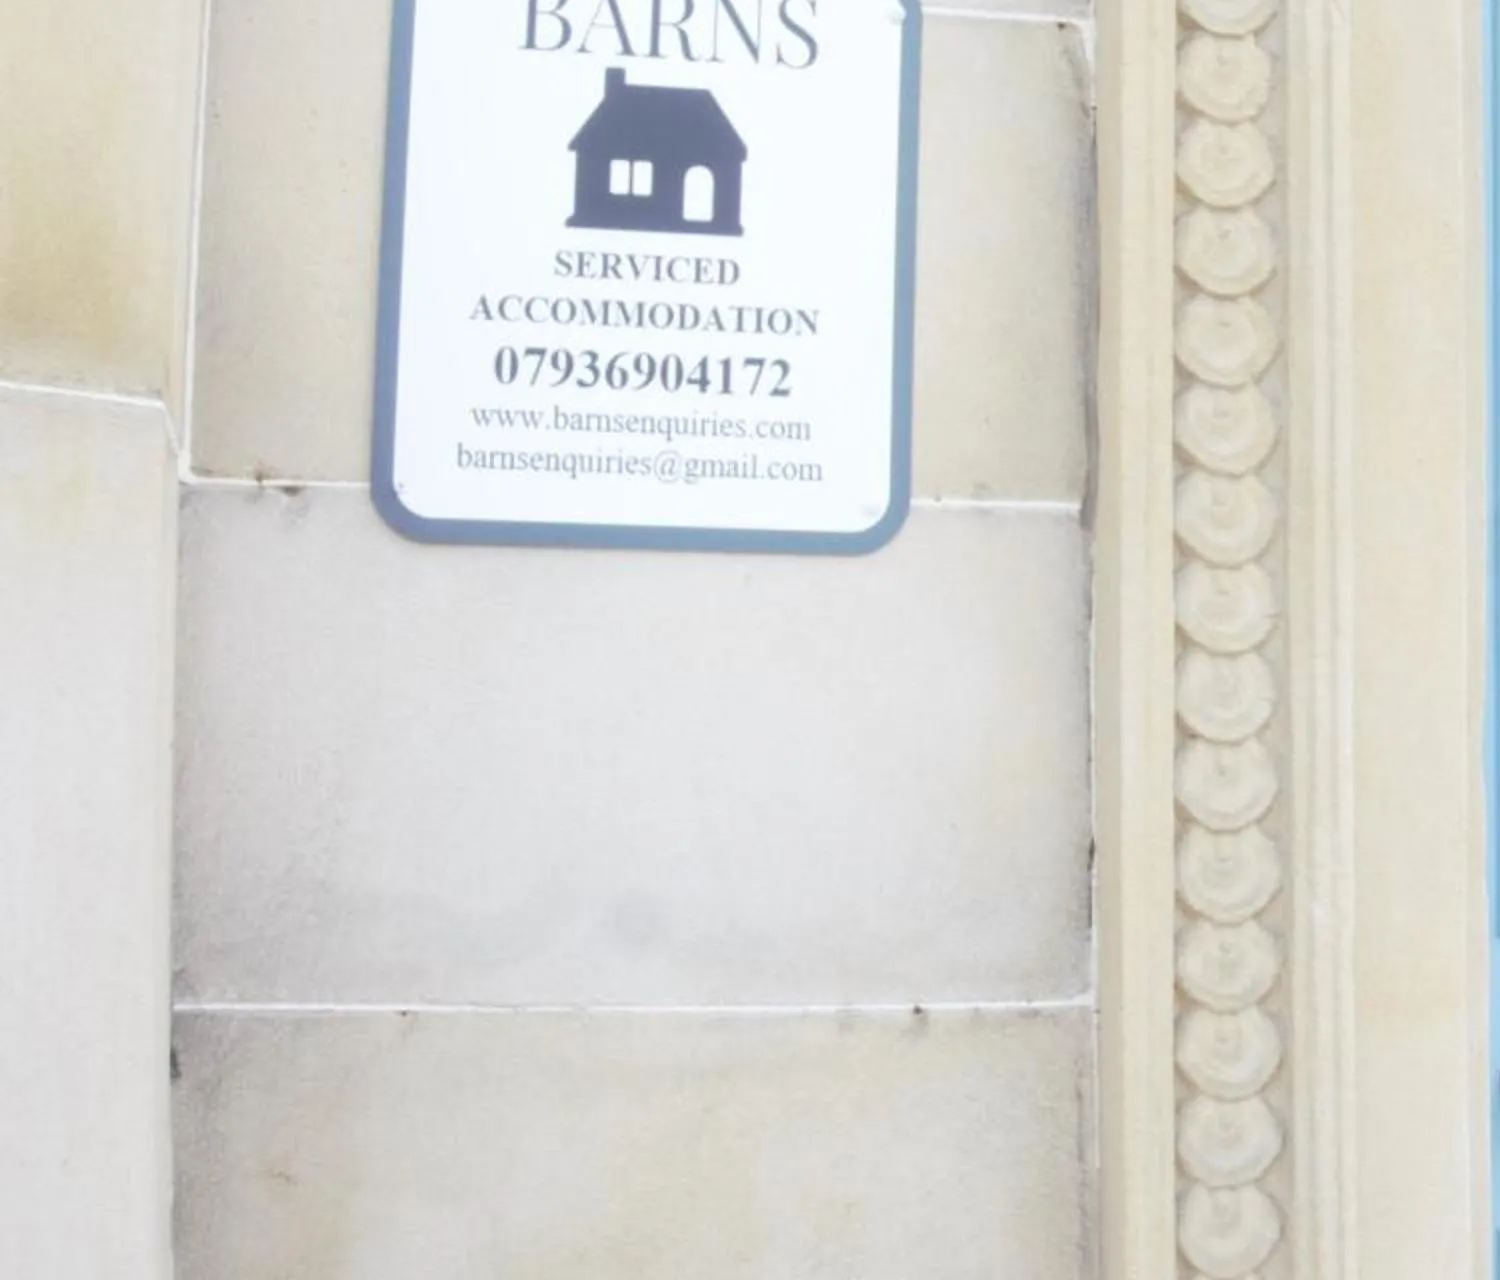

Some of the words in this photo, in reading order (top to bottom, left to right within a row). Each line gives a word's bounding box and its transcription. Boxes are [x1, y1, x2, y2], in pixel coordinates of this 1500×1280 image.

[552, 248, 742, 287] SERVICED
[468, 293, 821, 337] ACCOMMODATION
[492, 345, 793, 398] 07936904172
[469, 404, 813, 443] www.barnsenquiries.com
[456, 442, 825, 486] barnsenquiries@gmail.com
